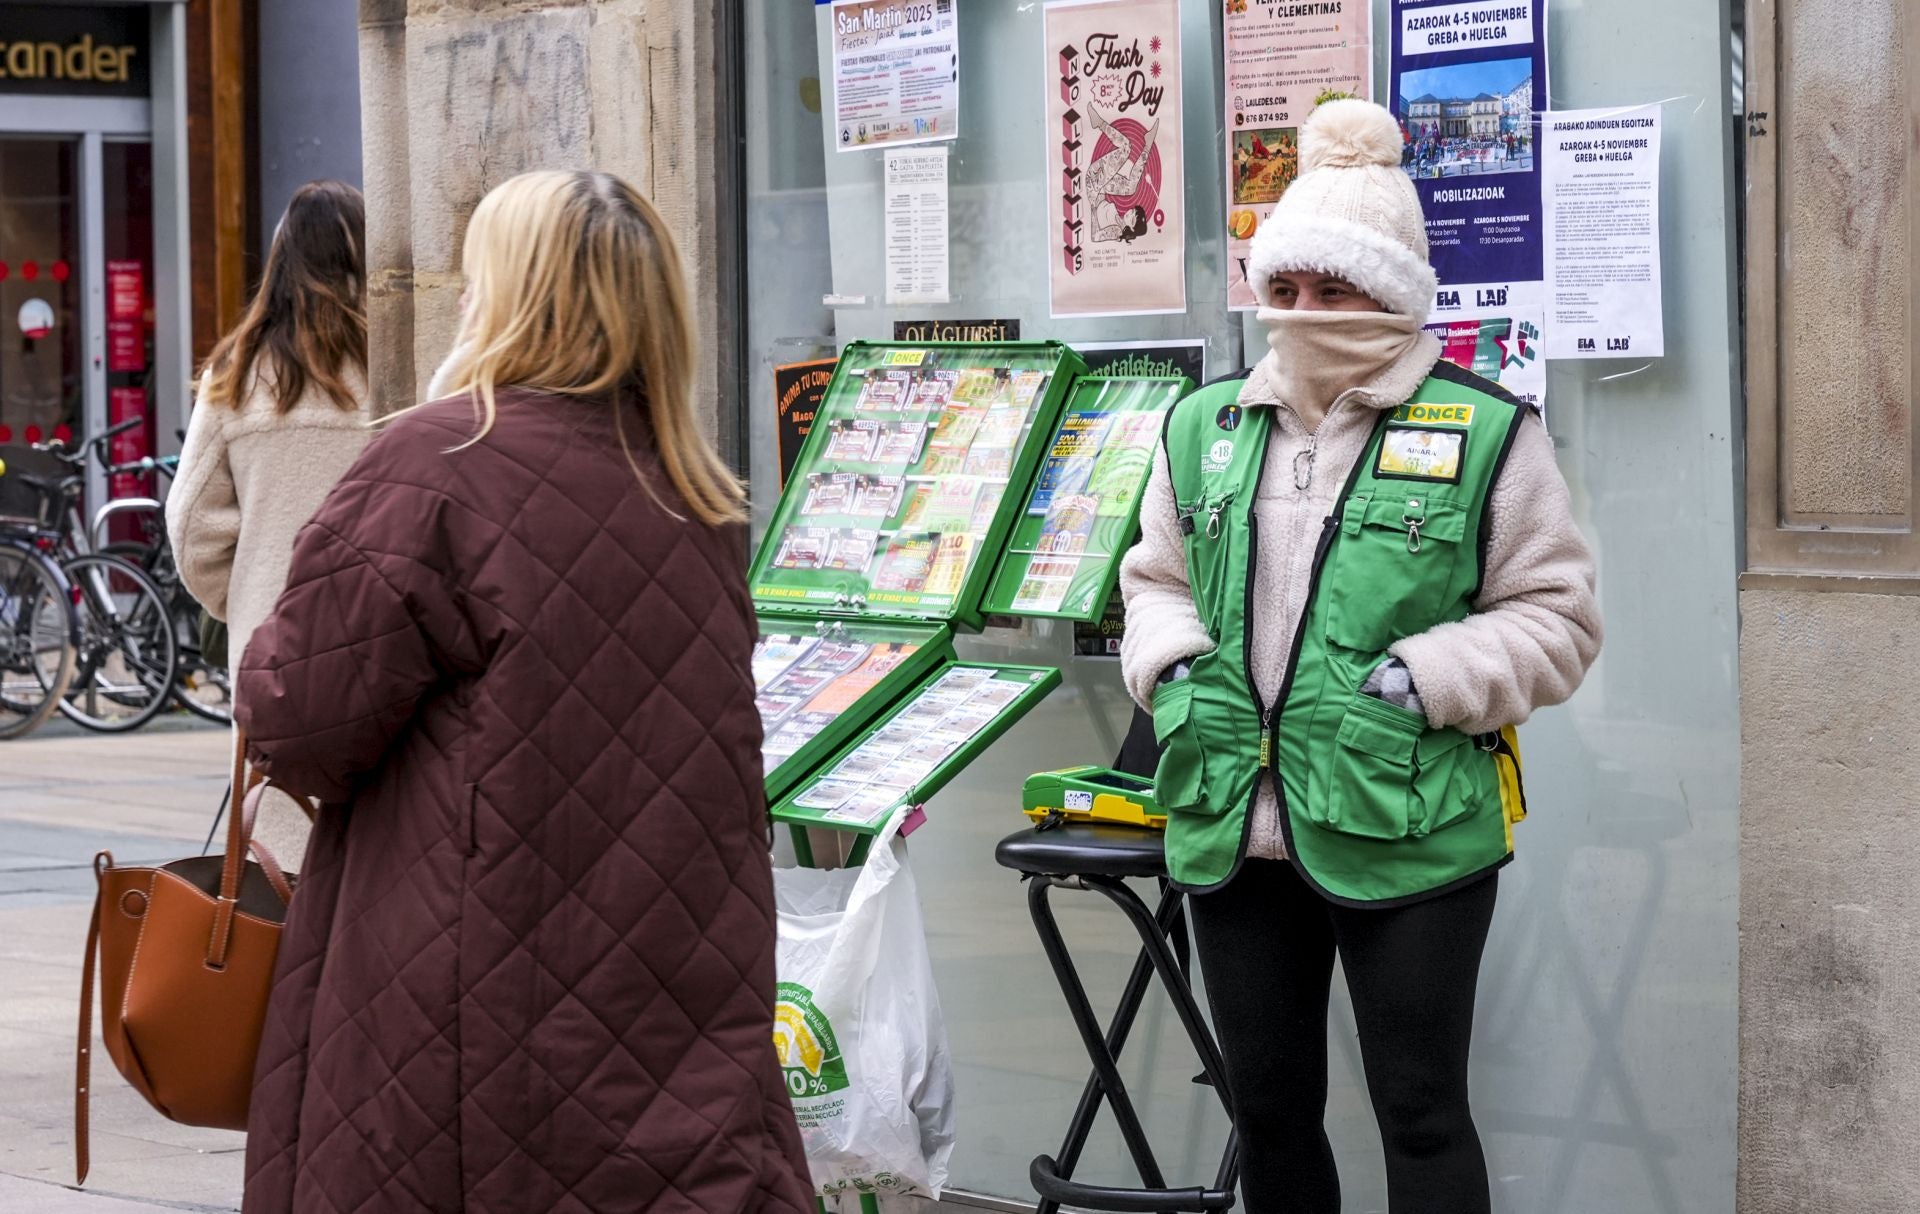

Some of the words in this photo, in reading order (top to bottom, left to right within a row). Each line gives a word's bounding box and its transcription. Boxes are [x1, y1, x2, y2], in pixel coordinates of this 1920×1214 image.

[1268, 8, 1275, 19] Y
[1278, 2, 1342, 18] CLEMENTINAS
[838, 12, 860, 36] San
[863, 6, 902, 31] Martin
[1407, 15, 1451, 31] AZAROAK
[1453, 12, 1470, 26] 4-5
[1472, 6, 1528, 24] NOVIEMBRE
[1427, 31, 1459, 46] GREBA
[1470, 26, 1507, 42] HUELGA
[1084, 33, 1144, 77] Flash
[1101, 84, 1106, 97] 8
[1118, 70, 1163, 116] Day
[1245, 96, 1287, 107] LAULEDES.COM
[1246, 113, 1258, 123] 676
[1258, 113, 1274, 122] 874
[1275, 112, 1289, 121] 929
[1553, 121, 1585, 131] ARABAKO
[1585, 120, 1620, 130] ADINDUEN
[1621, 119, 1654, 129] EGOITZAK
[1559, 142, 1592, 151] AZAROAK
[1593, 140, 1606, 150] 4-5
[1607, 139, 1648, 150] NOVIEMBRE
[1574, 153, 1597, 163] GREBA
[1605, 152, 1633, 162] HUELGA
[1433, 187, 1505, 203] MOBILIZAZIOAK
[1436, 218, 1466, 226] NOVIEMBRE
[1473, 216, 1496, 225] AZAROAK
[1501, 214, 1530, 223] NOVIEMBRE
[1436, 291, 1461, 306] ELA
[1577, 338, 1596, 349] ELA
[895, 352, 921, 363] ONCE
[780, 381, 801, 416] ANIMA
[801, 373, 811, 391] TU
[1412, 406, 1467, 420] ONCE
[1406, 447, 1438, 457] AINARA
[783, 1069, 828, 1095] 0%
[811, 1098, 845, 1111] RECICLADO
[815, 1108, 844, 1120] RECICLAT
